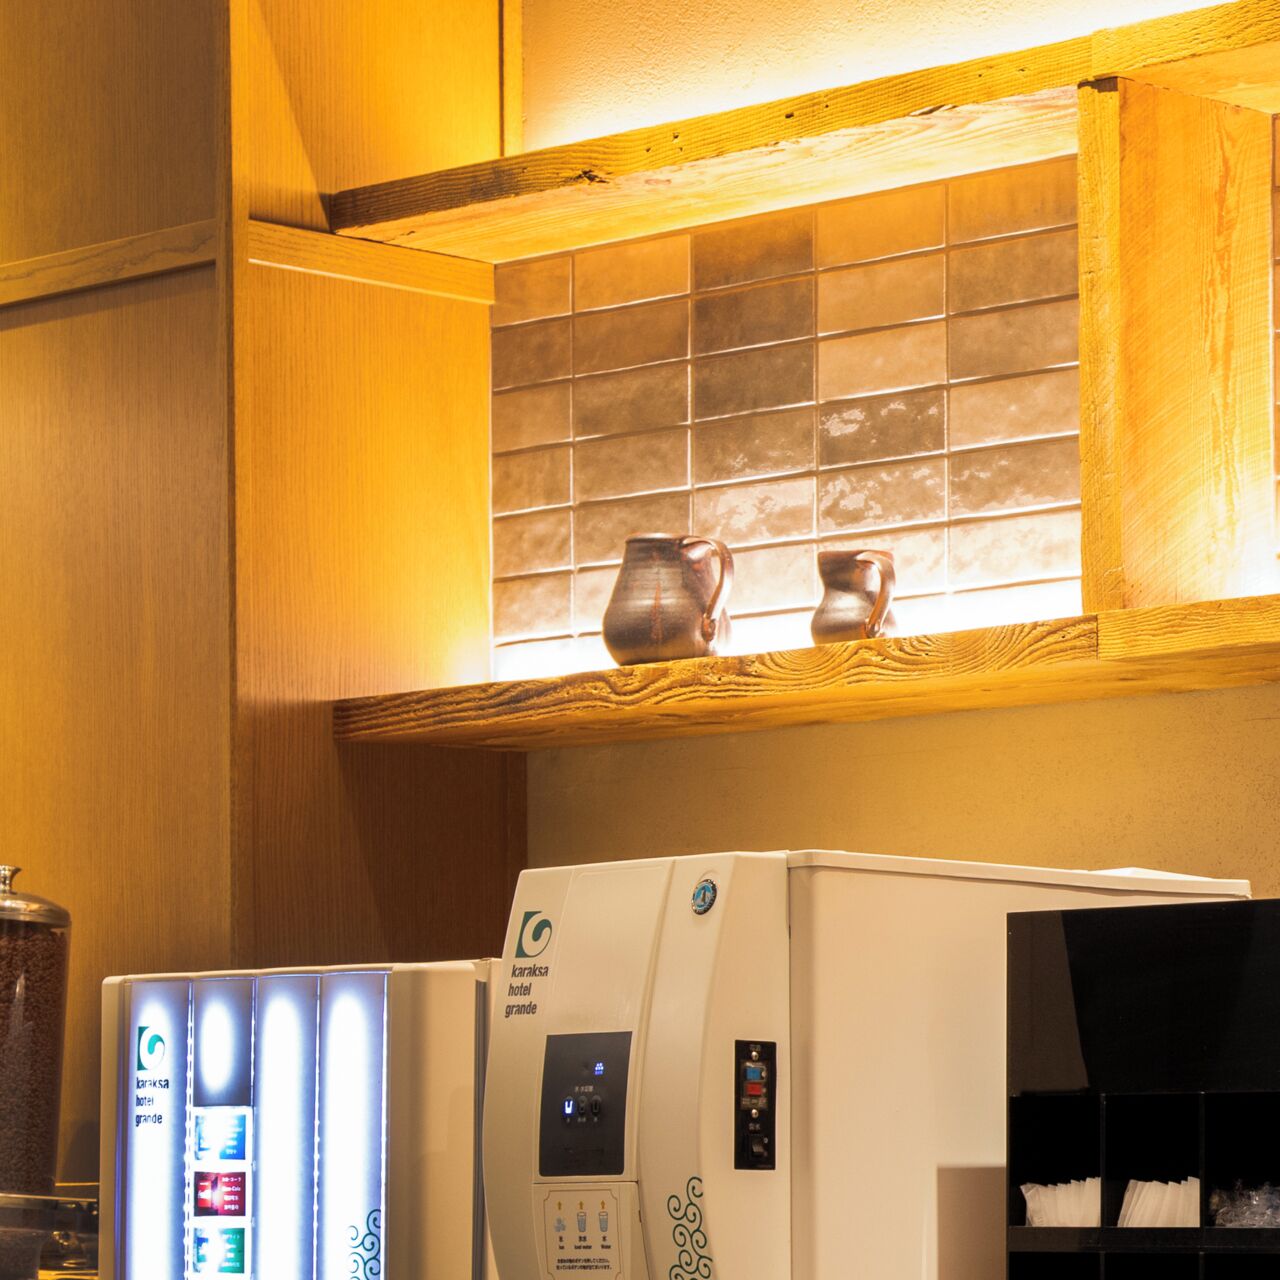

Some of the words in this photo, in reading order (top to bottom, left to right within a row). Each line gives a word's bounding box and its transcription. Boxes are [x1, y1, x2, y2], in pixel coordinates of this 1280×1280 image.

[511, 964, 549, 978] karaksa
[508, 982, 532, 996] hotel
[504, 1001, 537, 1018] grande
[136, 1077, 169, 1089] karaksa
[135, 1113, 162, 1127] grande
